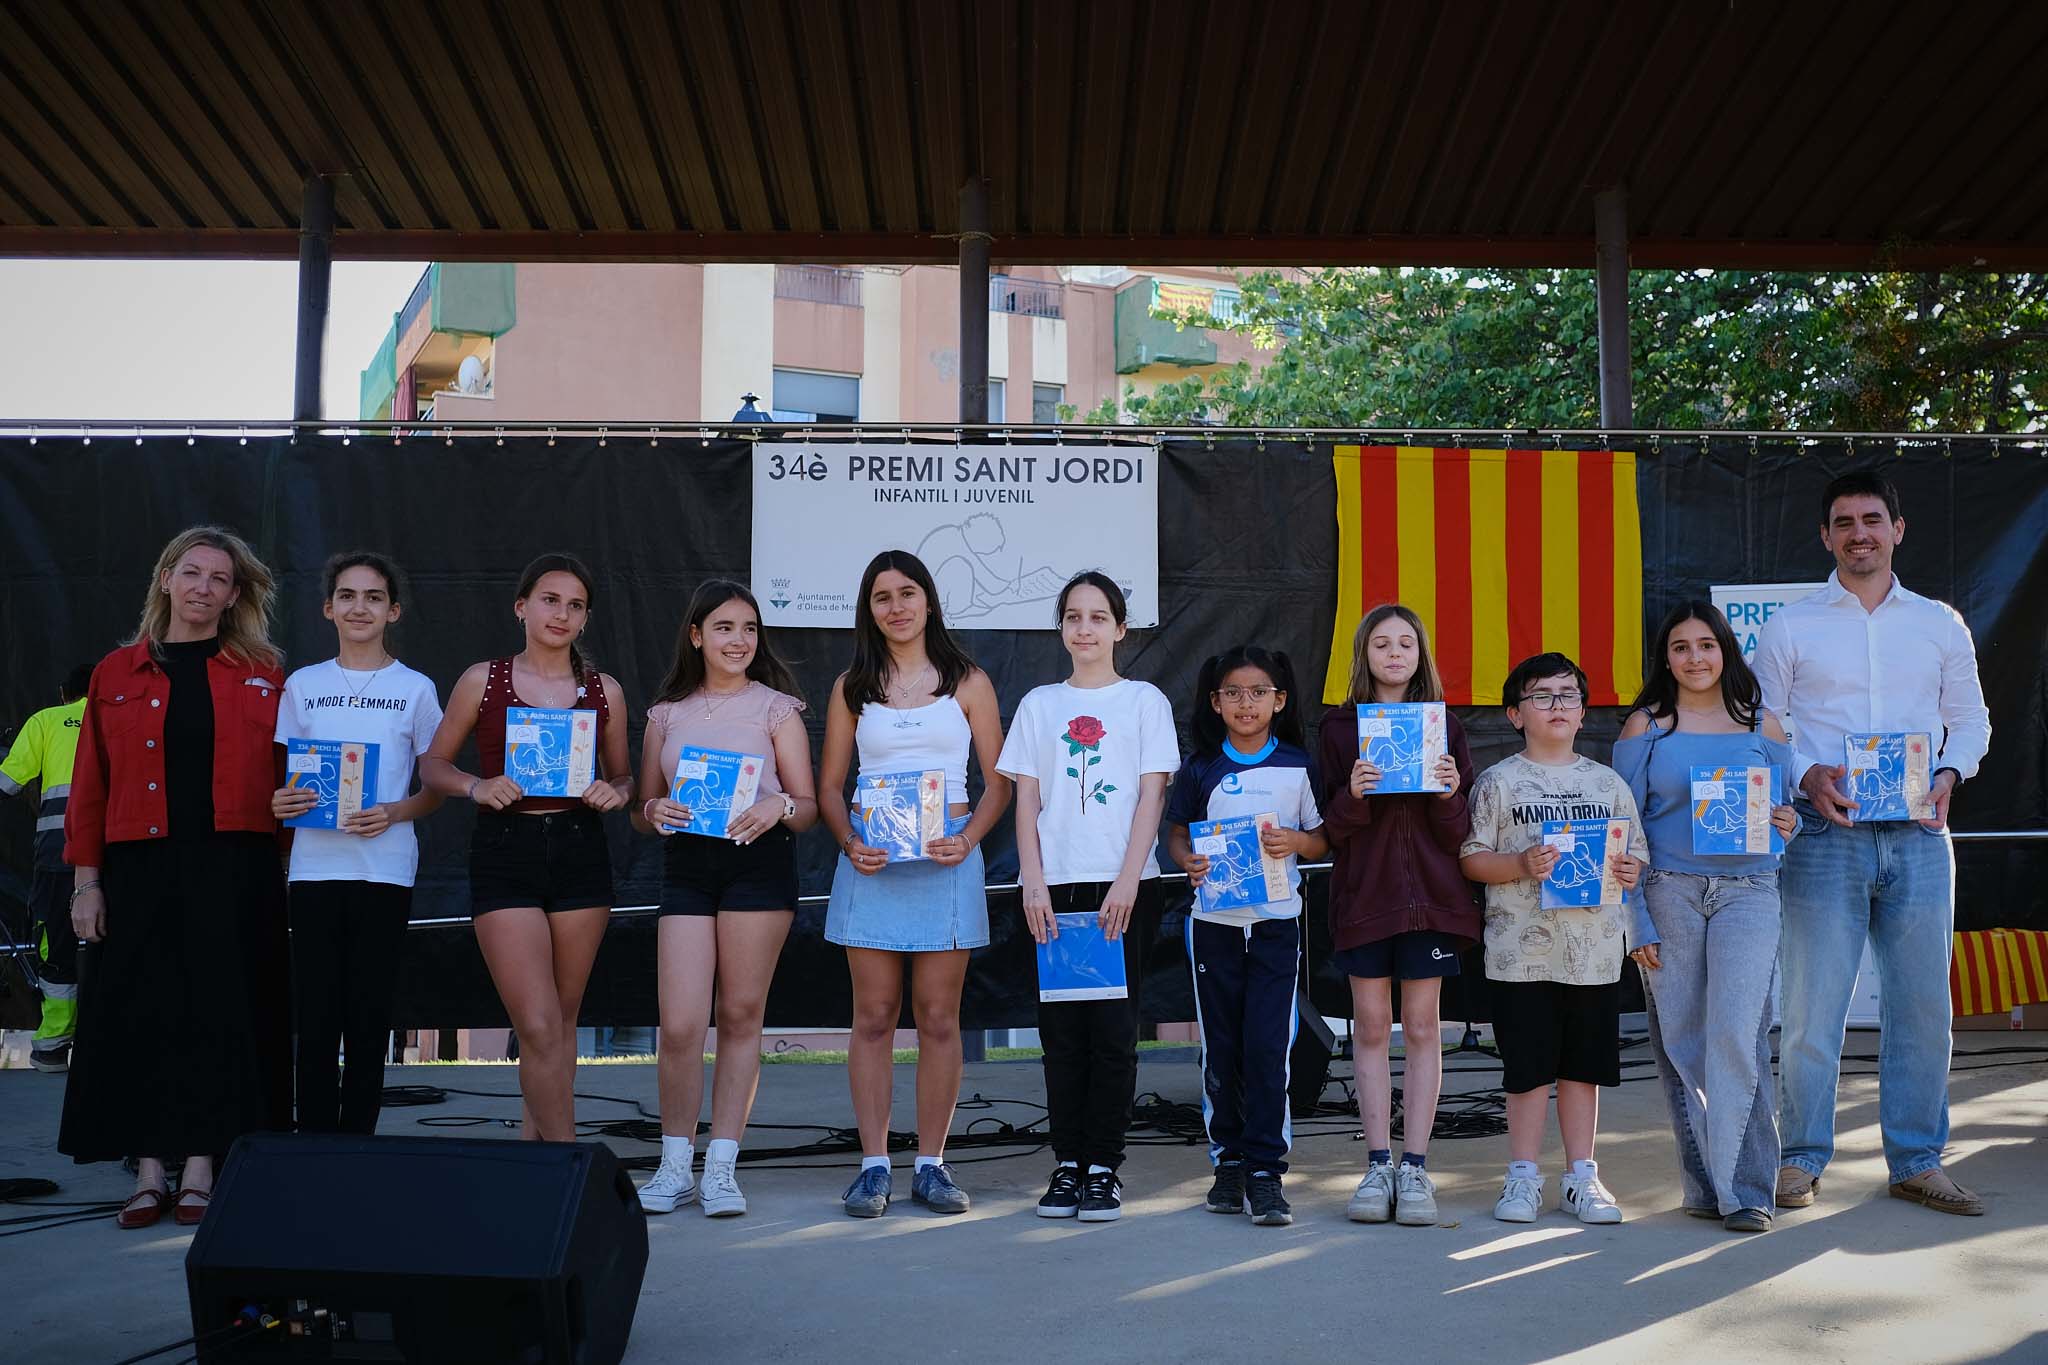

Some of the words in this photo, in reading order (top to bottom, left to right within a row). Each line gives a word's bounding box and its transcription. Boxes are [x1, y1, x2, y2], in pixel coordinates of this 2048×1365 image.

[768, 452, 828, 481] 34è
[849, 455, 944, 482] PREMI
[954, 456, 1037, 483] SANT
[1046, 457, 1143, 484] JORDI
[874, 488, 949, 503] INFANTIL
[954, 488, 958, 503] I
[964, 489, 1034, 504] JUVENIL
[797, 593, 845, 602] Ajuntament
[829, 603, 840, 611] de
[1726, 602, 1785, 626] PRE
[317, 696, 346, 709] MODE
